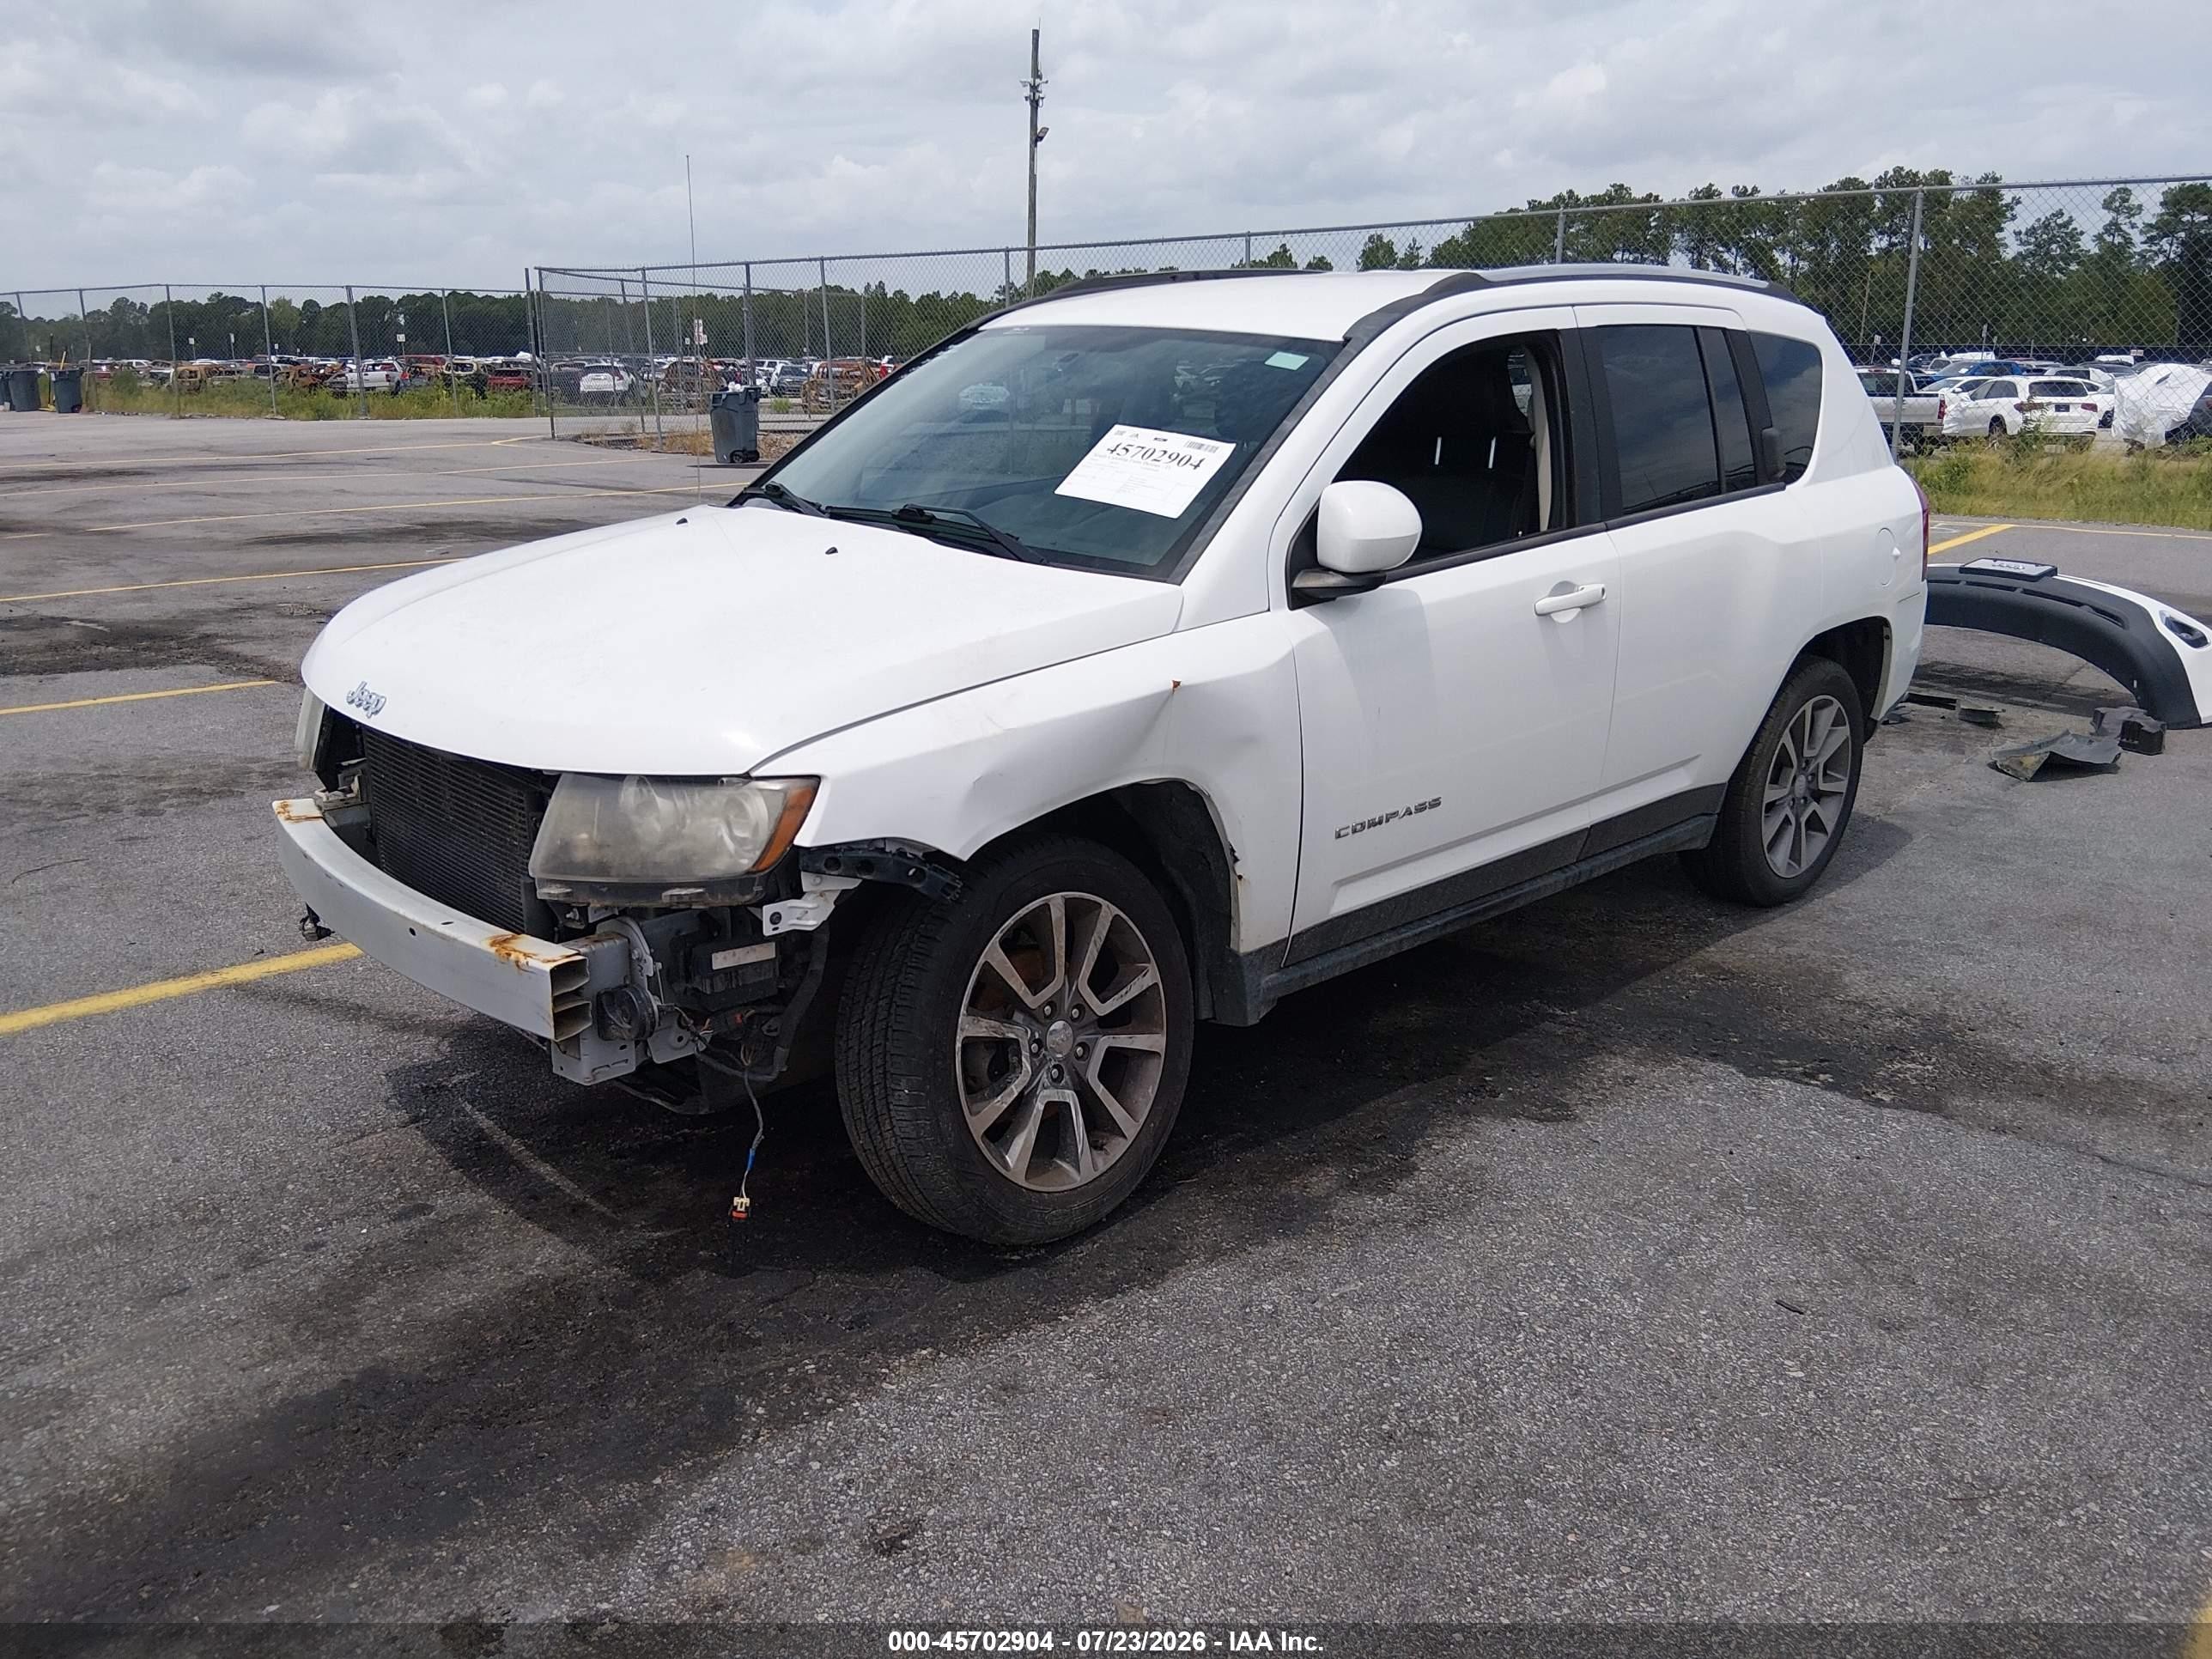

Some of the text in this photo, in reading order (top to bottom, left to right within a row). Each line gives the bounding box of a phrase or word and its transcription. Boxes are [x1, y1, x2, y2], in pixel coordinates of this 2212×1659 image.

[1106, 441, 1206, 471] 45702904
[346, 681, 387, 720] Jeep
[1334, 796, 1443, 840] COMPASS
